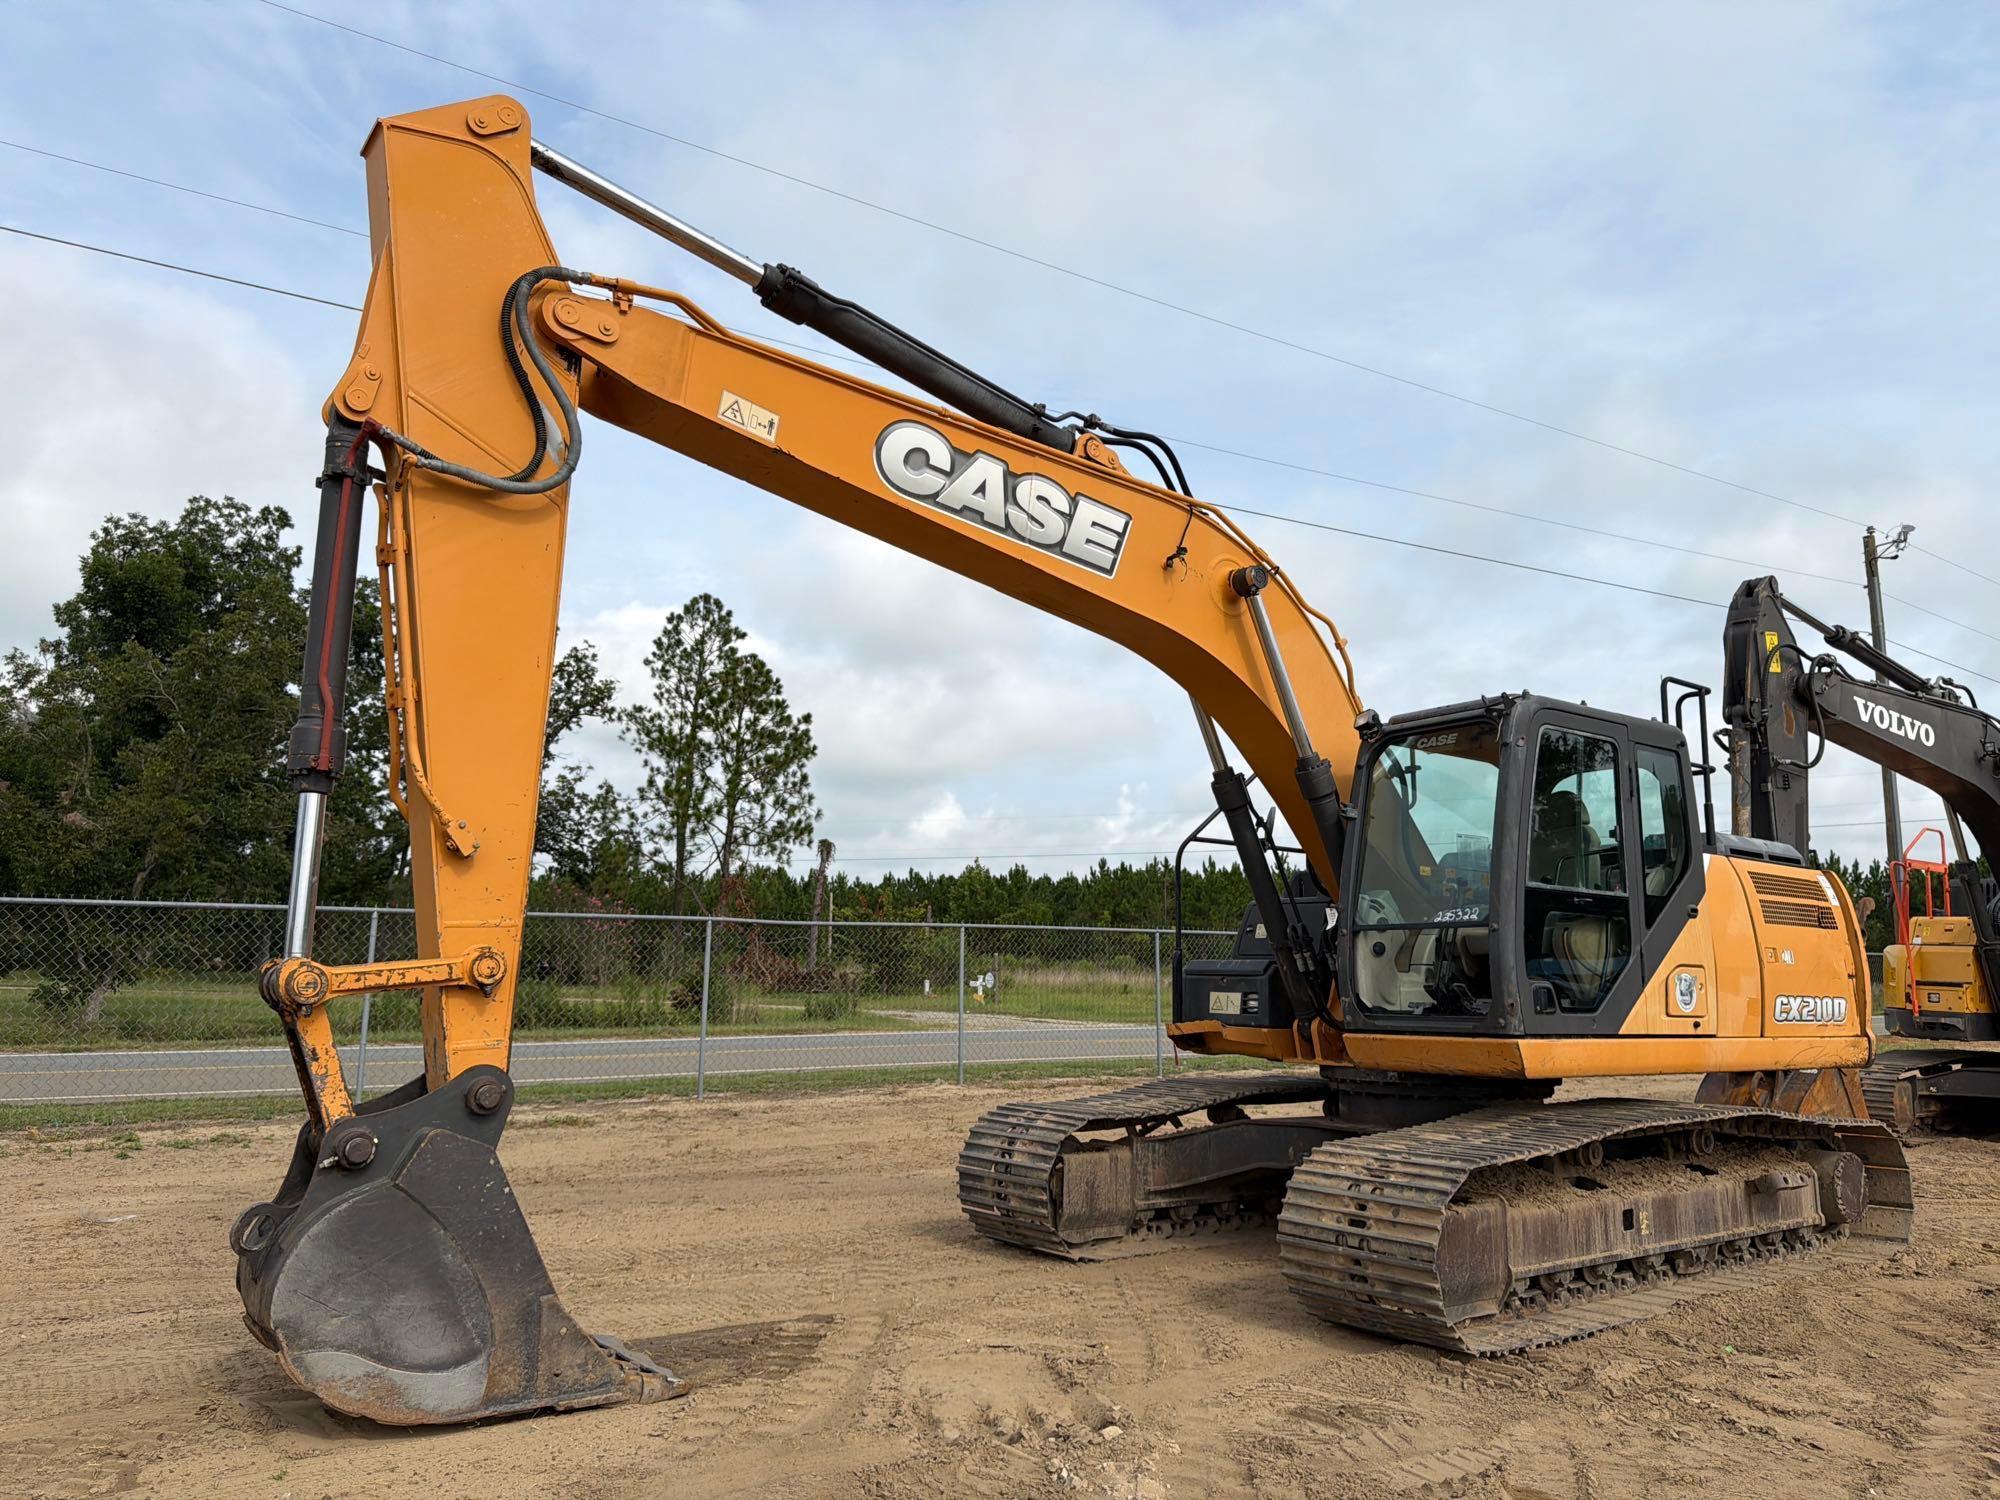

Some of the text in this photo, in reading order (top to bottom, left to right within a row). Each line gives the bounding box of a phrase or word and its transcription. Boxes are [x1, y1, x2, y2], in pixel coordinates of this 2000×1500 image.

[879, 426, 1127, 571] CASE
[1416, 732, 1459, 749] CASE
[1853, 695, 1935, 747] VOLVO
[1773, 994, 1848, 1023] CX210D
